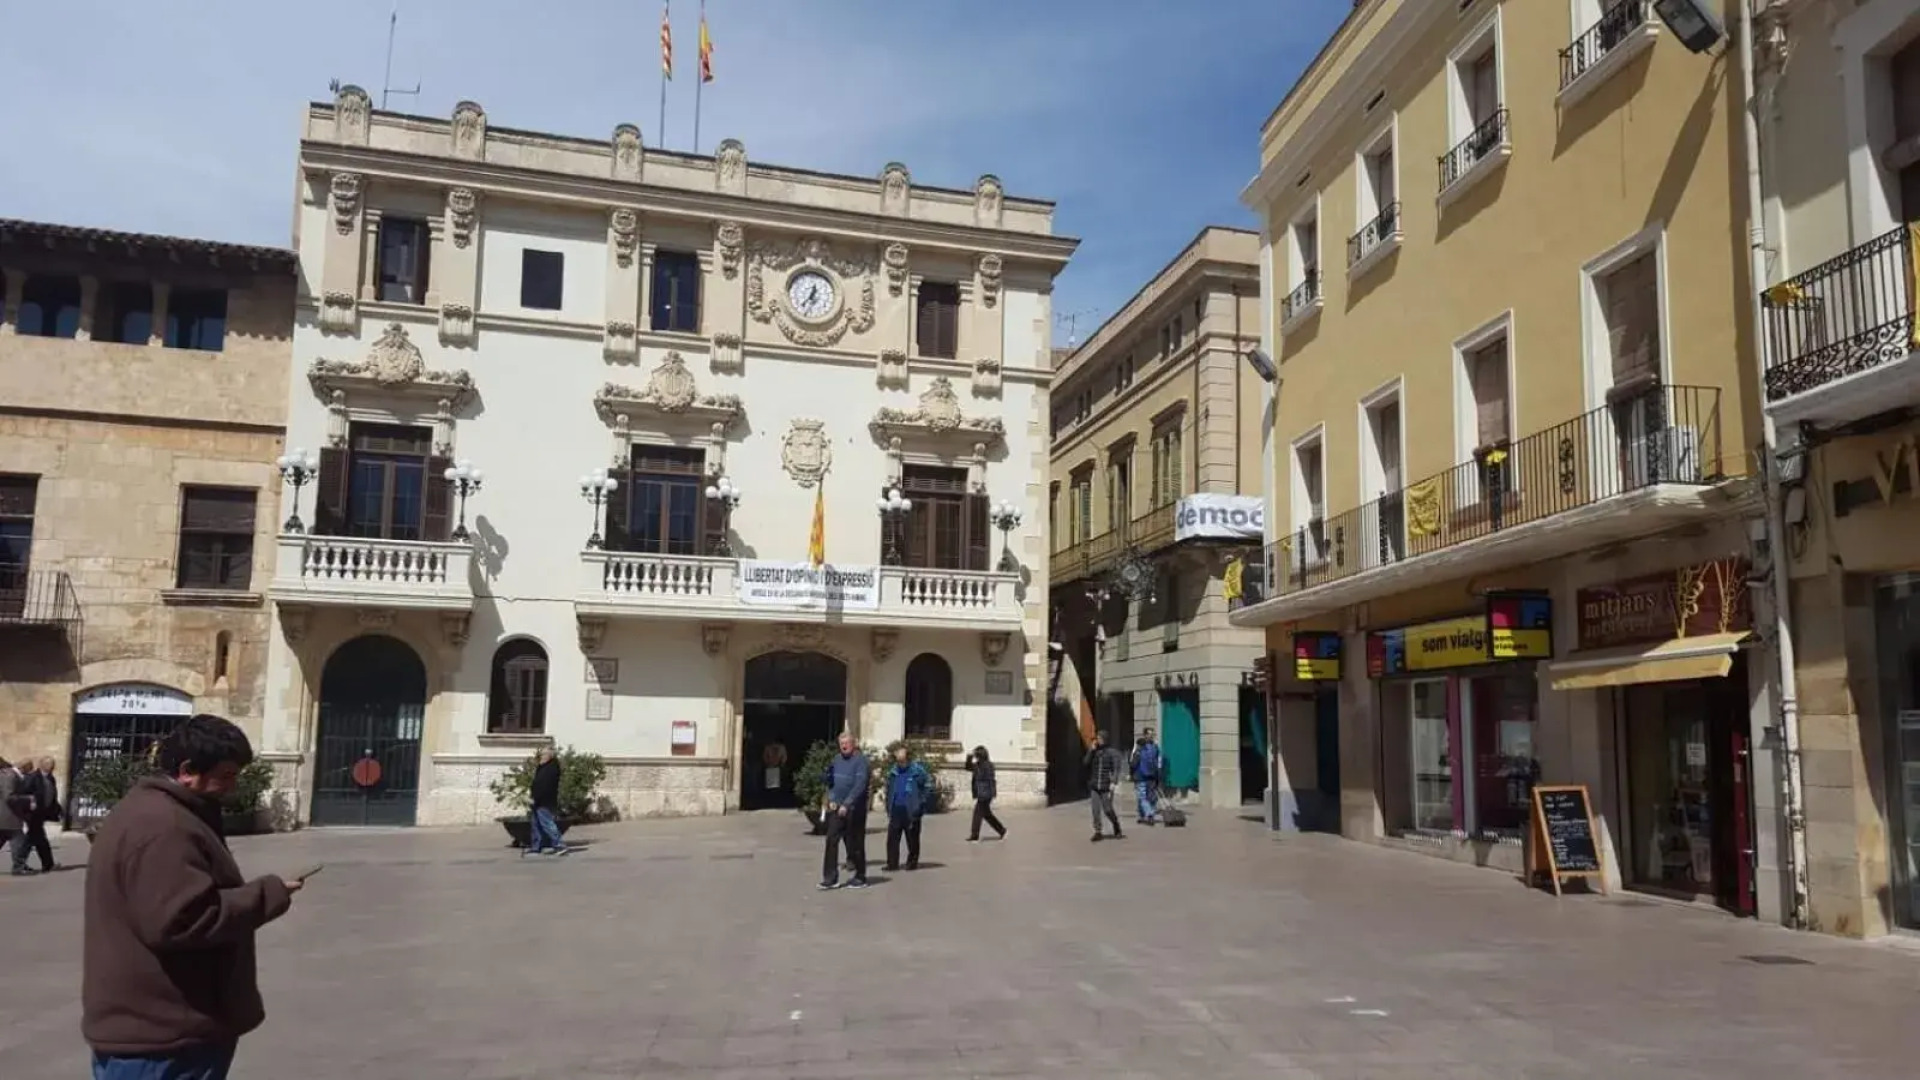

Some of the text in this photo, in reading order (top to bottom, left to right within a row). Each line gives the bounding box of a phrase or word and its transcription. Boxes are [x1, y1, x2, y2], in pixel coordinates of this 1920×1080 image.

[744, 568, 784, 583] LLIBERTAT
[1584, 592, 1656, 622] mitjans
[1422, 636, 1448, 653] som
